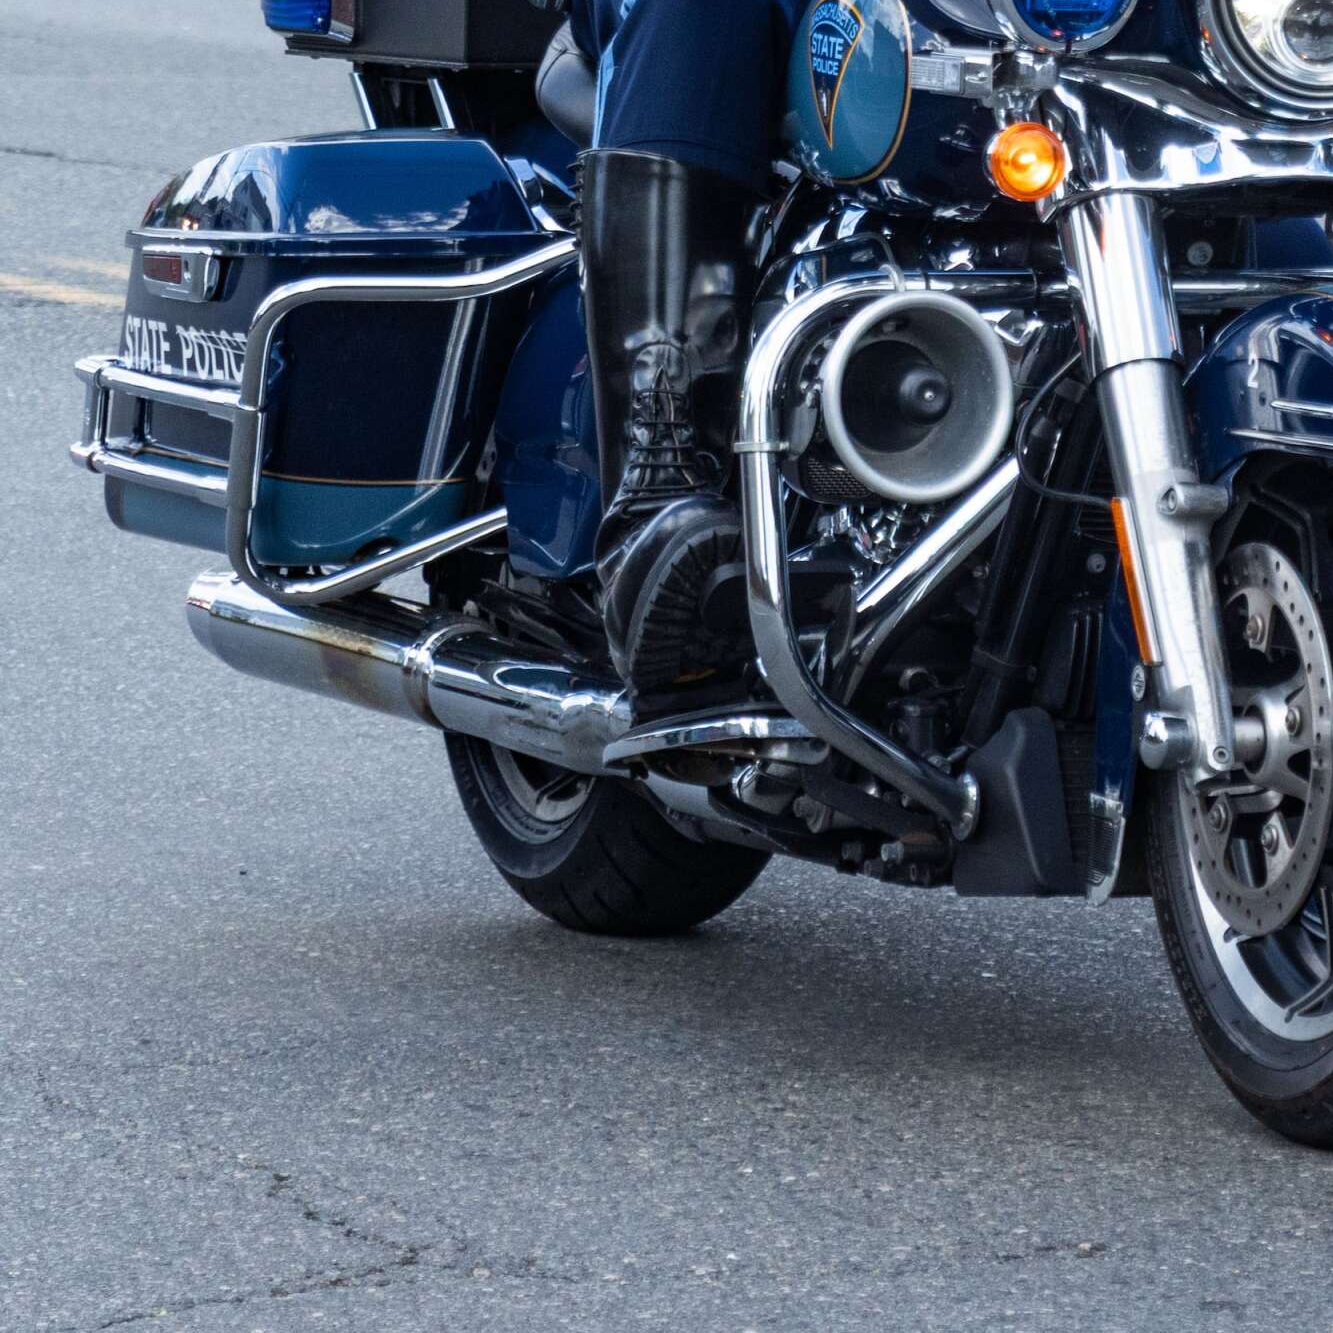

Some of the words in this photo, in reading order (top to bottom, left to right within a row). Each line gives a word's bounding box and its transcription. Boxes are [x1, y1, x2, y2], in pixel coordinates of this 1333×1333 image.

[812, 33, 844, 59] STATE
[812, 57, 839, 76] POLICE
[124, 314, 172, 375] STATE
[1247, 354, 1259, 388] 2
